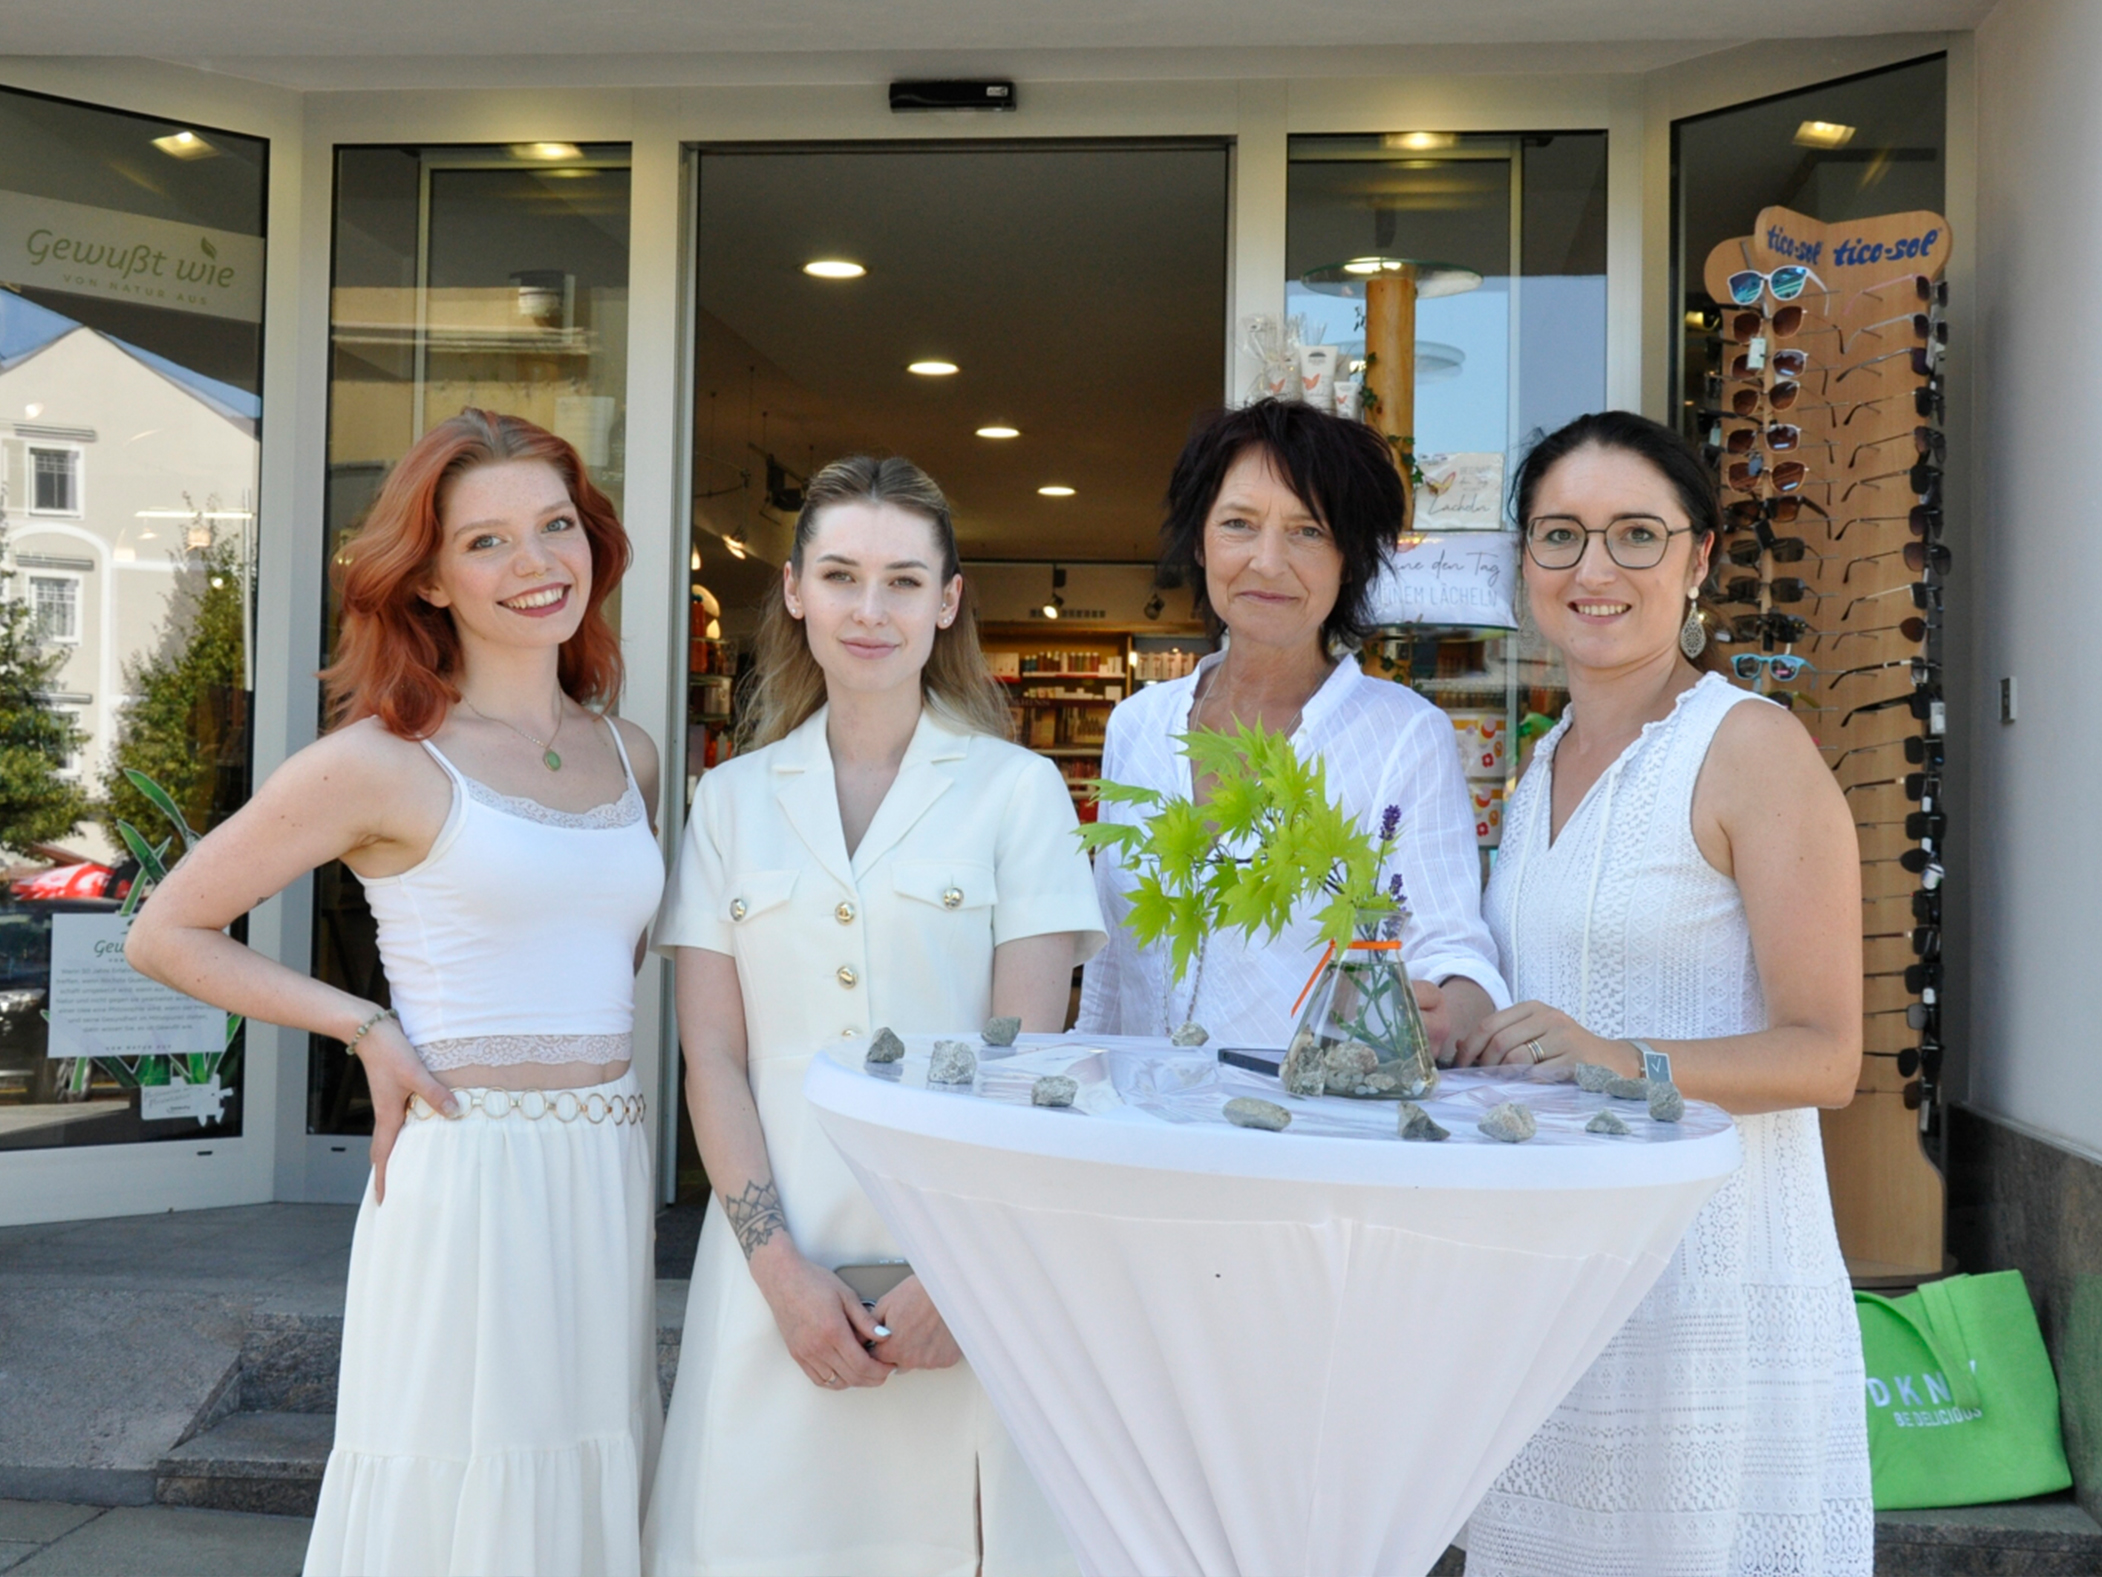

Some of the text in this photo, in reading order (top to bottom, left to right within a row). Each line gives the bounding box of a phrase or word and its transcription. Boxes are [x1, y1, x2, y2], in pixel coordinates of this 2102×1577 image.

[27, 229, 235, 289] Gewußt wie
[1767, 224, 1823, 266] tico-sol
[1833, 228, 1938, 267] tico-sol
[63, 274, 207, 305] VON NATUR AUS
[1431, 549, 1464, 579] den
[1466, 551, 1500, 587] Tag
[1430, 583, 1498, 608] LÄCHELN
[1866, 1359, 1976, 1408] DKN
[1895, 1407, 1982, 1427] BE DELICIOUS
